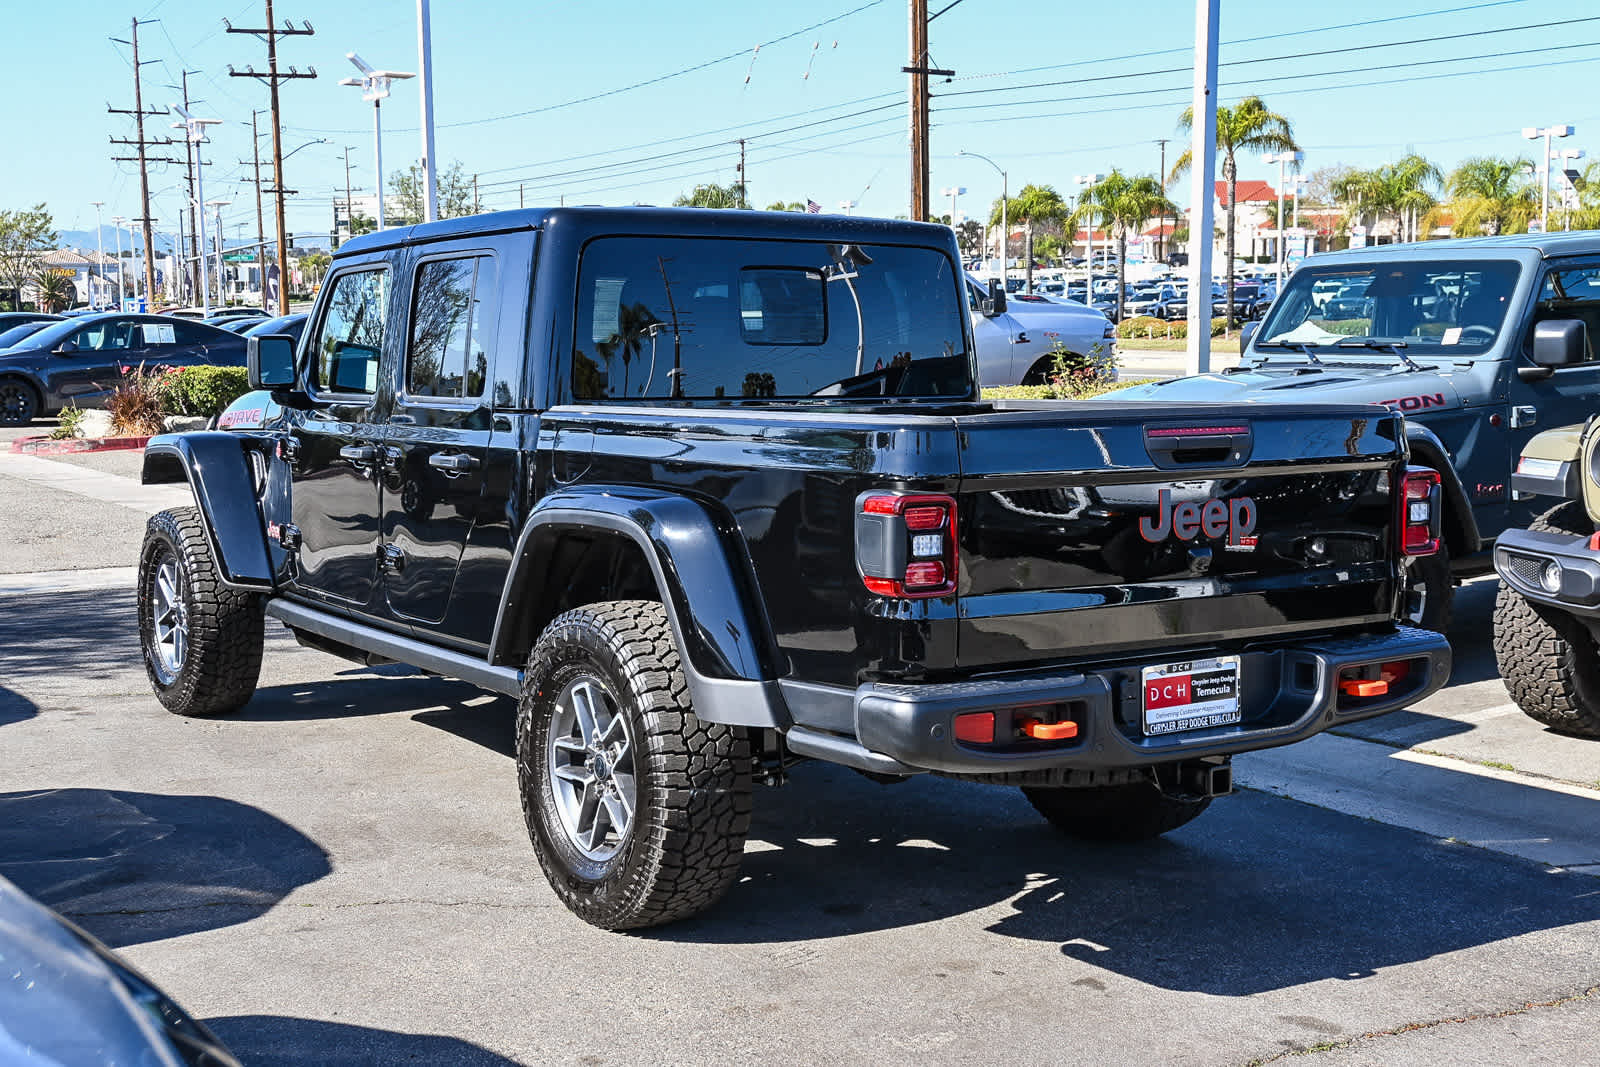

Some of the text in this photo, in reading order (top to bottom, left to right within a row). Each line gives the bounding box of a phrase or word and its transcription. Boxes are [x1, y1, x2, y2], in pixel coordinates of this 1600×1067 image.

[1139, 488, 1257, 546] Jeep
[1197, 685, 1230, 696] Temecula
[1177, 720, 1188, 730] JEEP
[1189, 717, 1209, 727] DODGE
